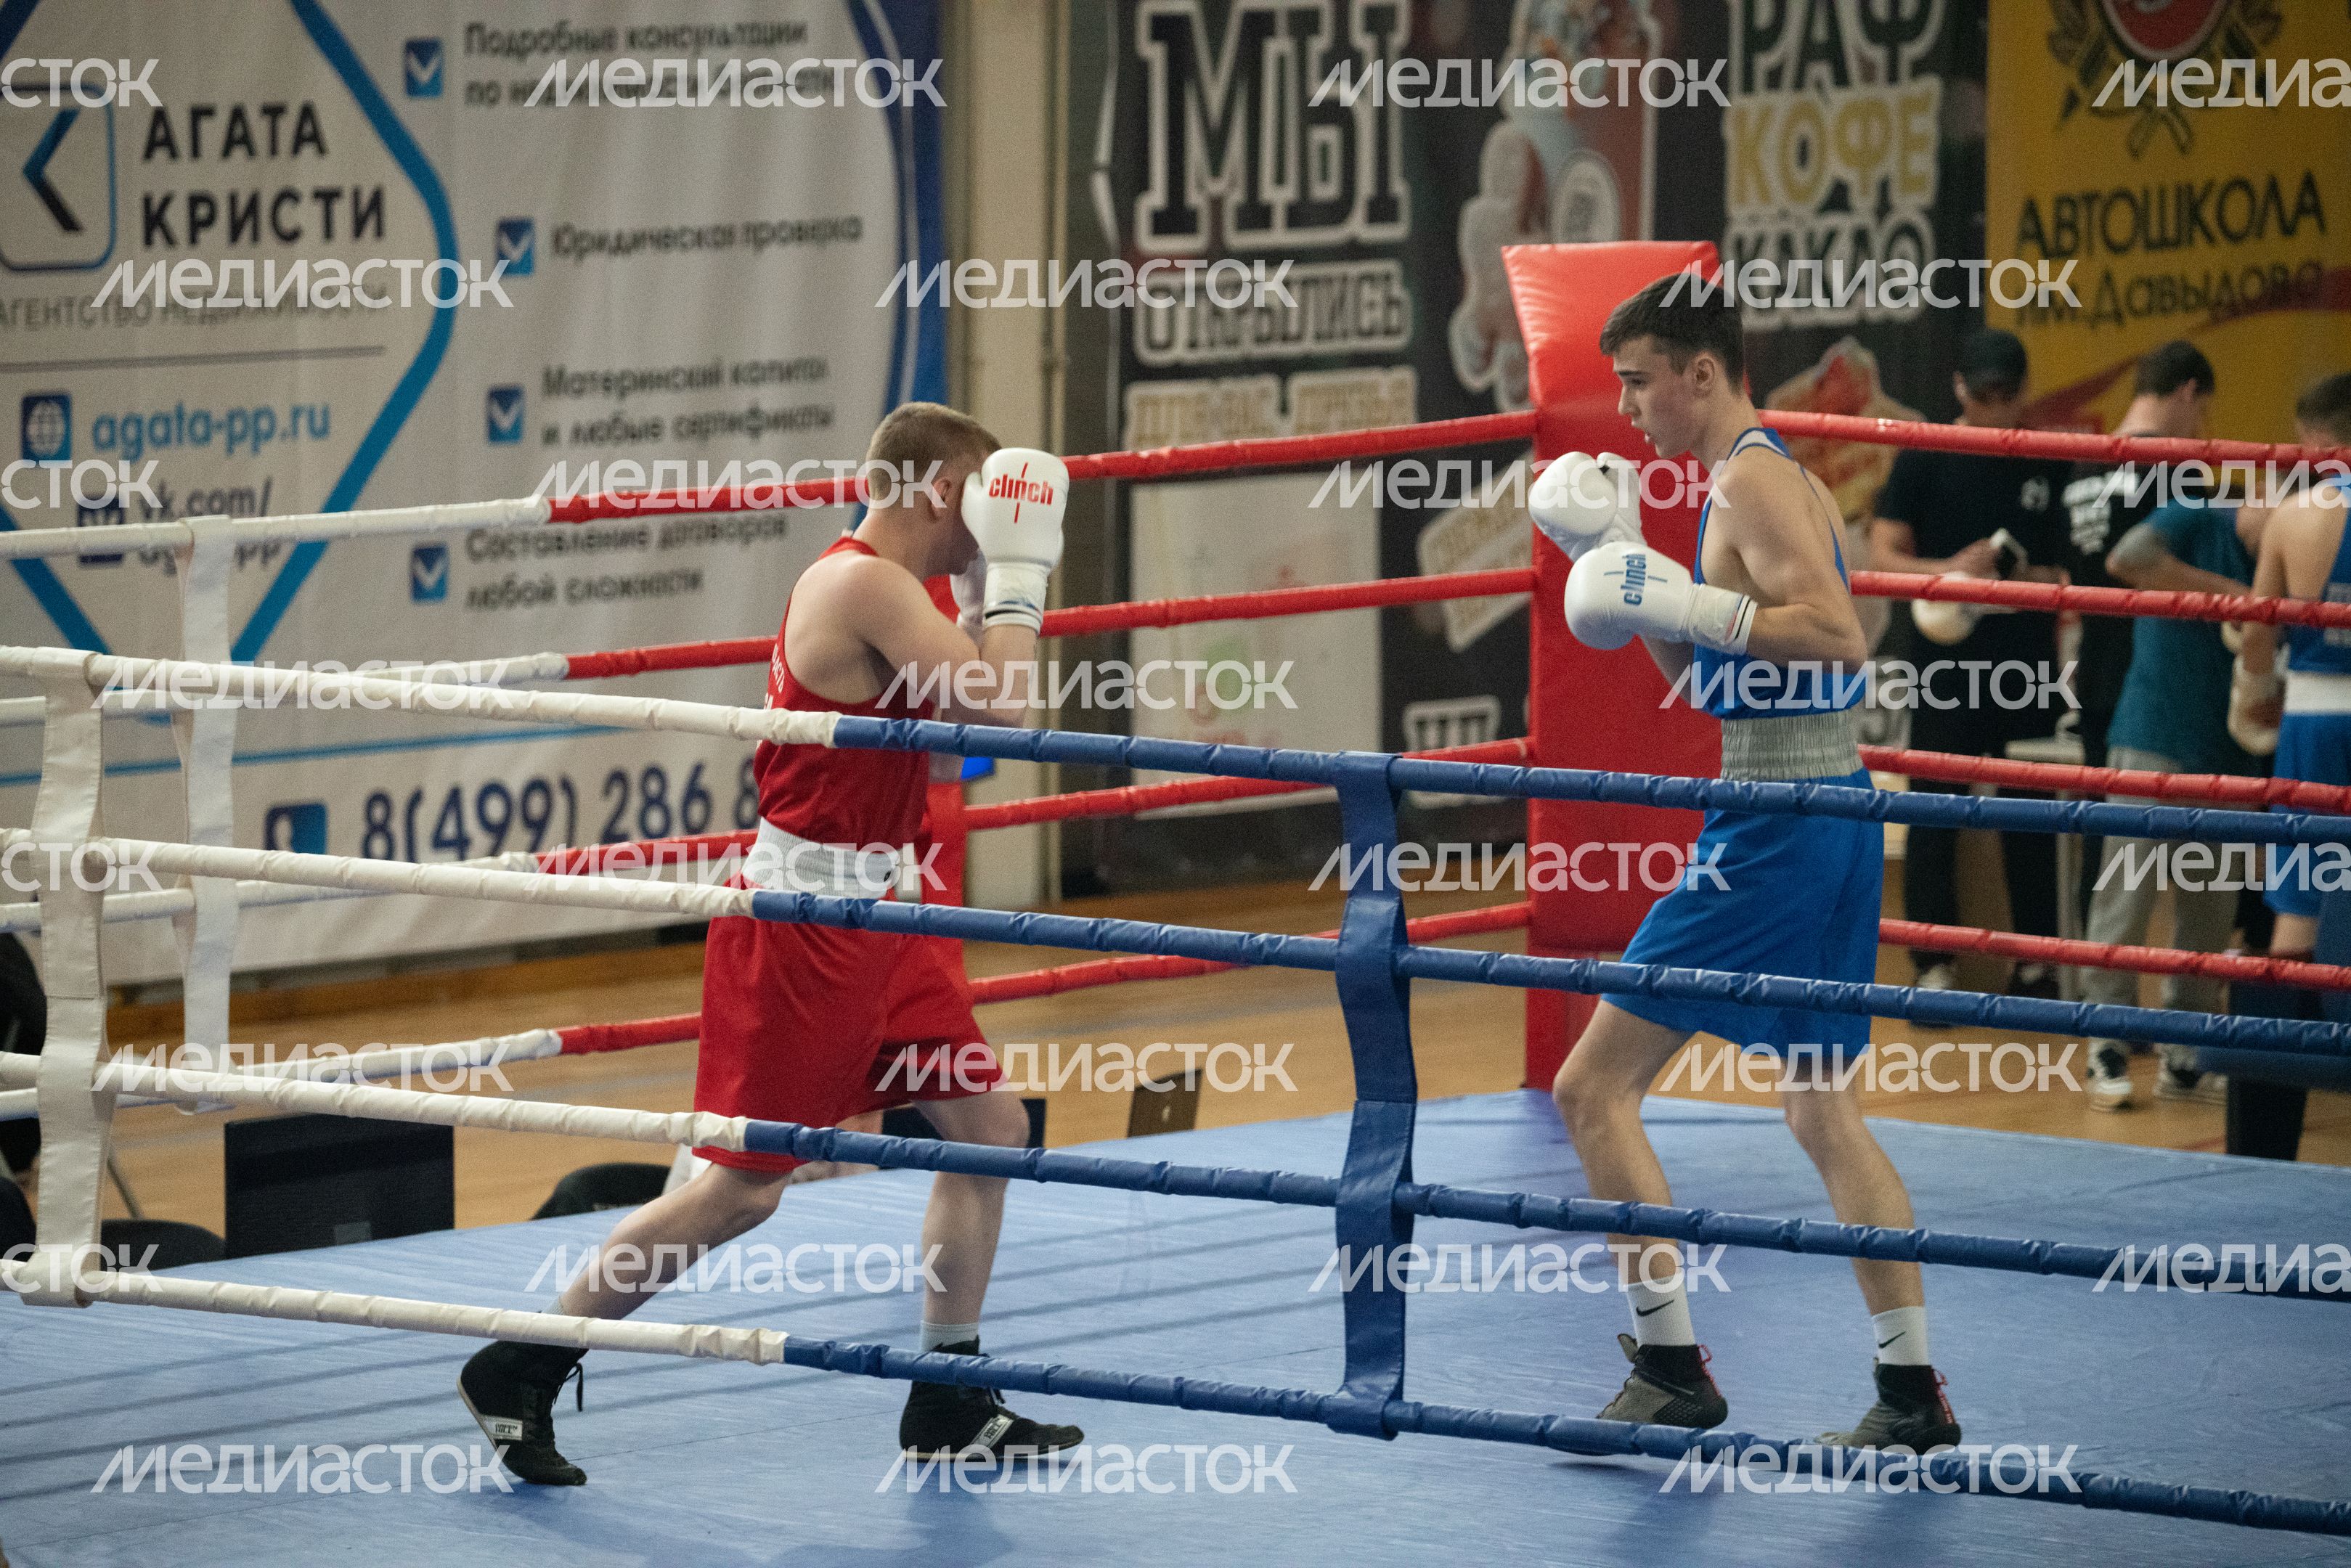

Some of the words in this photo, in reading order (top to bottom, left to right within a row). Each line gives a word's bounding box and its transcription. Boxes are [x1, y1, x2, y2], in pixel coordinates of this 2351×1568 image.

[143, 102, 327, 161] АГАТА
[1138, 2, 1409, 245] МЫ
[1729, 91, 1934, 206] КОФЕ
[143, 184, 386, 248] КРИСТИ
[2016, 171, 2326, 259] АВТОШКОЛА
[93, 402, 330, 462] agata-pp.ru
[988, 473, 1054, 506] clinch
[1620, 554, 1647, 605] clinch
[600, 761, 714, 844] 286
